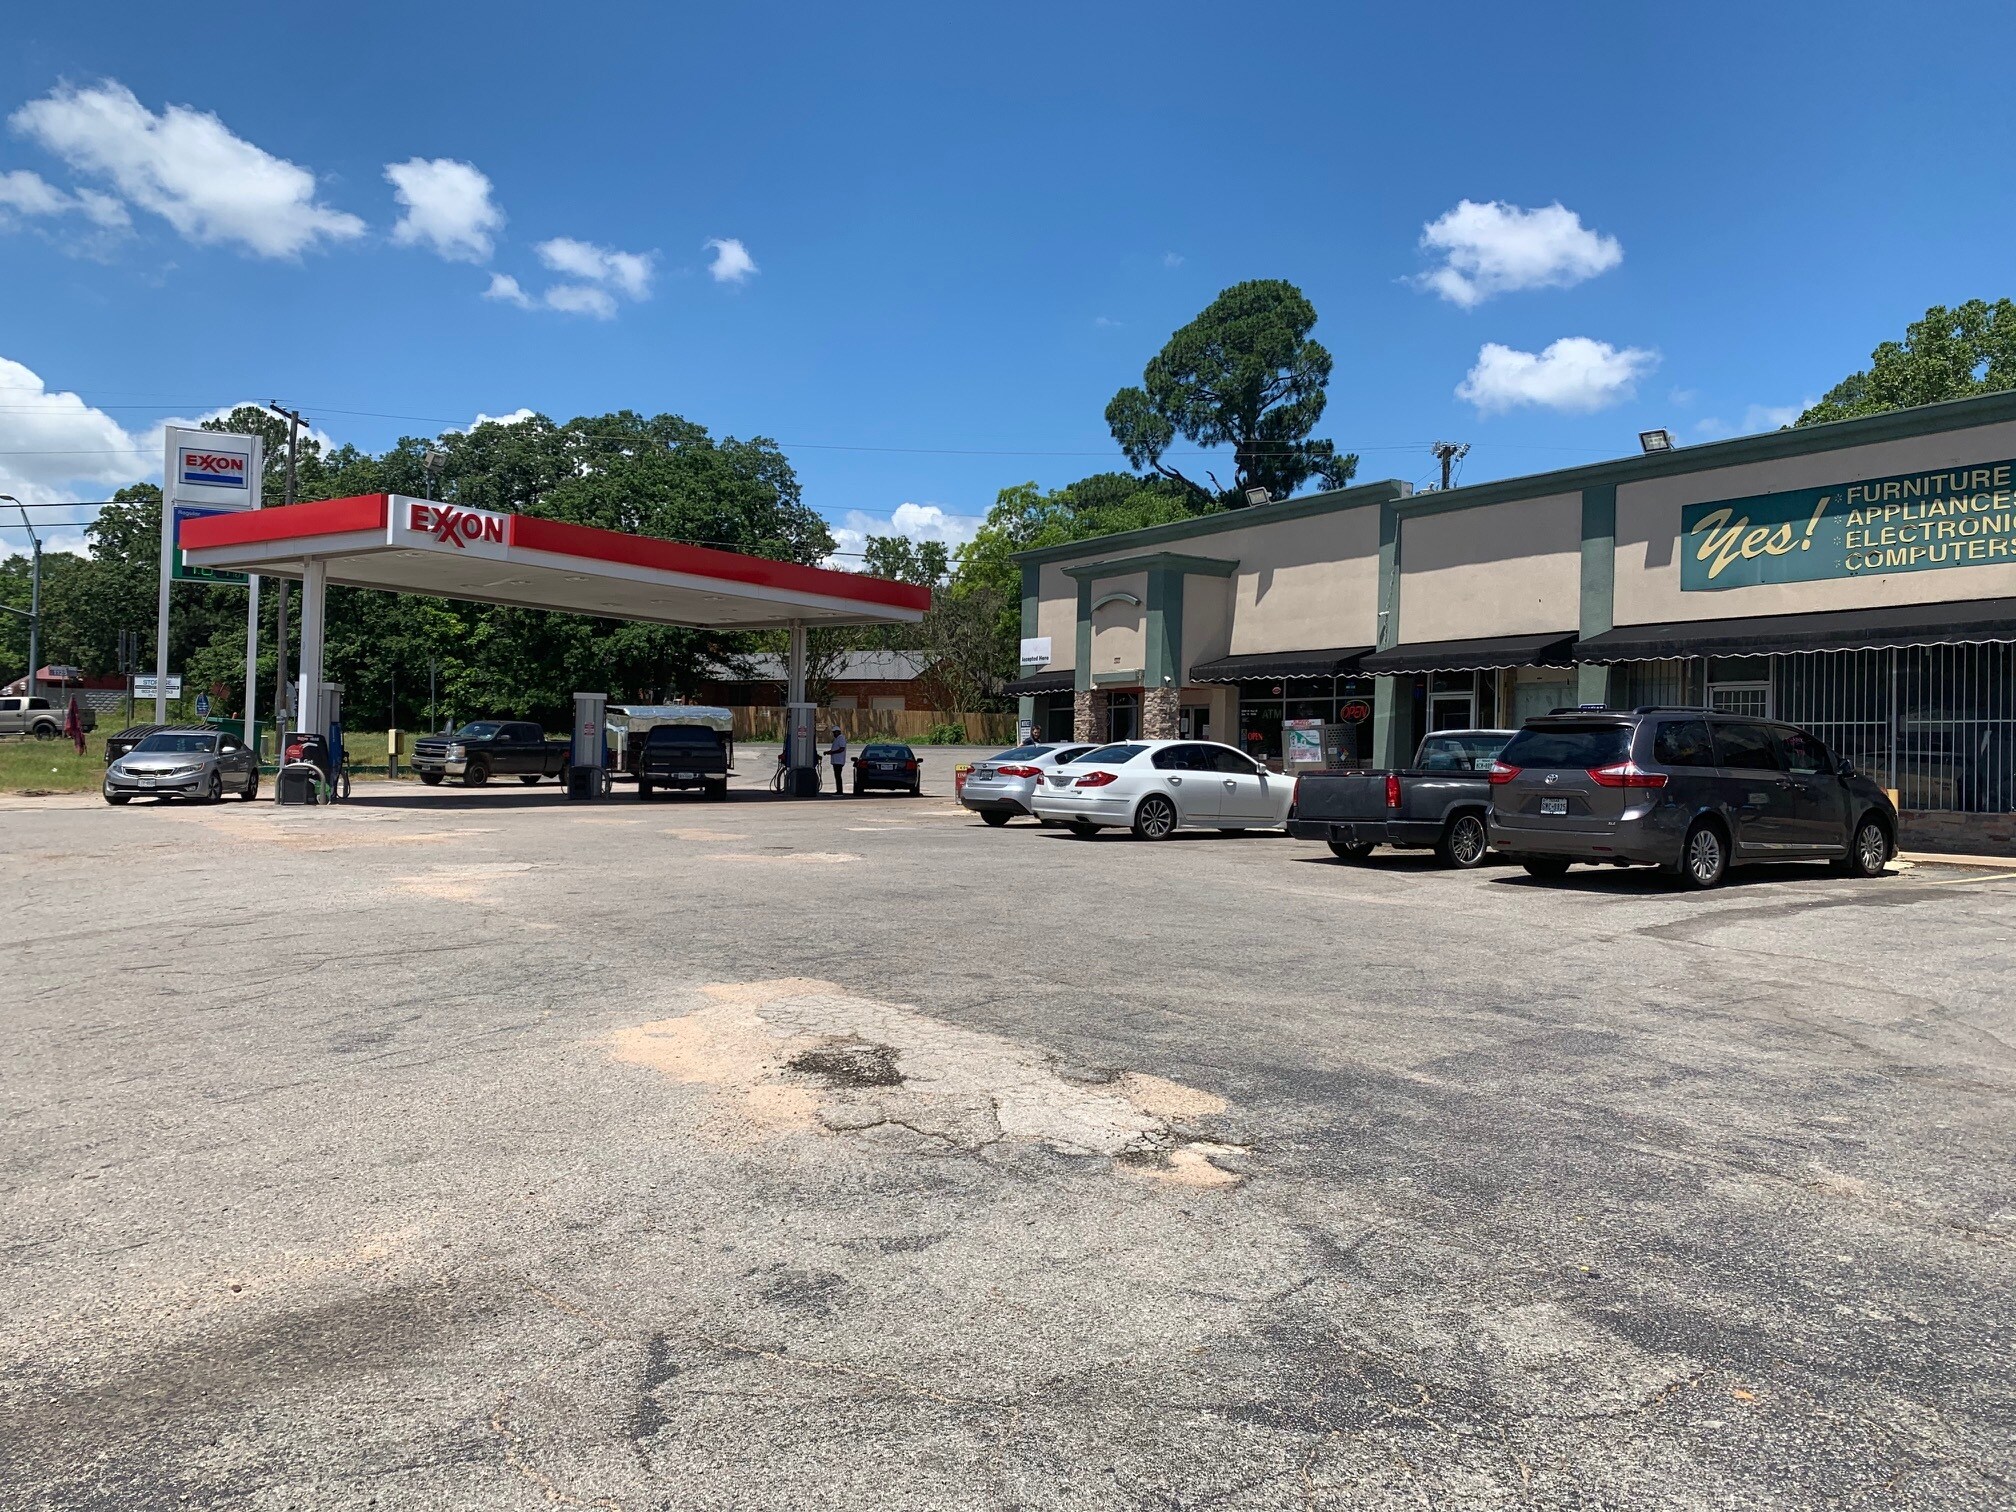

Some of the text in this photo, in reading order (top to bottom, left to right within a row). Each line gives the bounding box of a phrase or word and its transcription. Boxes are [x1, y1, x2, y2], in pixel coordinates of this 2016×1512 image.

[185, 455, 243, 473] EXXON
[1846, 466, 2012, 506] FURNITURE
[177, 509, 201, 517] Regular
[1846, 490, 2016, 528] APPLIANCE
[410, 504, 504, 549] EXXON
[1691, 497, 1831, 580] Yes!
[1846, 513, 2016, 550] ELECTRONI
[1262, 709, 1282, 719] ATM
[1342, 705, 1367, 719] OPEN
[1247, 732, 1263, 741] OPEN
